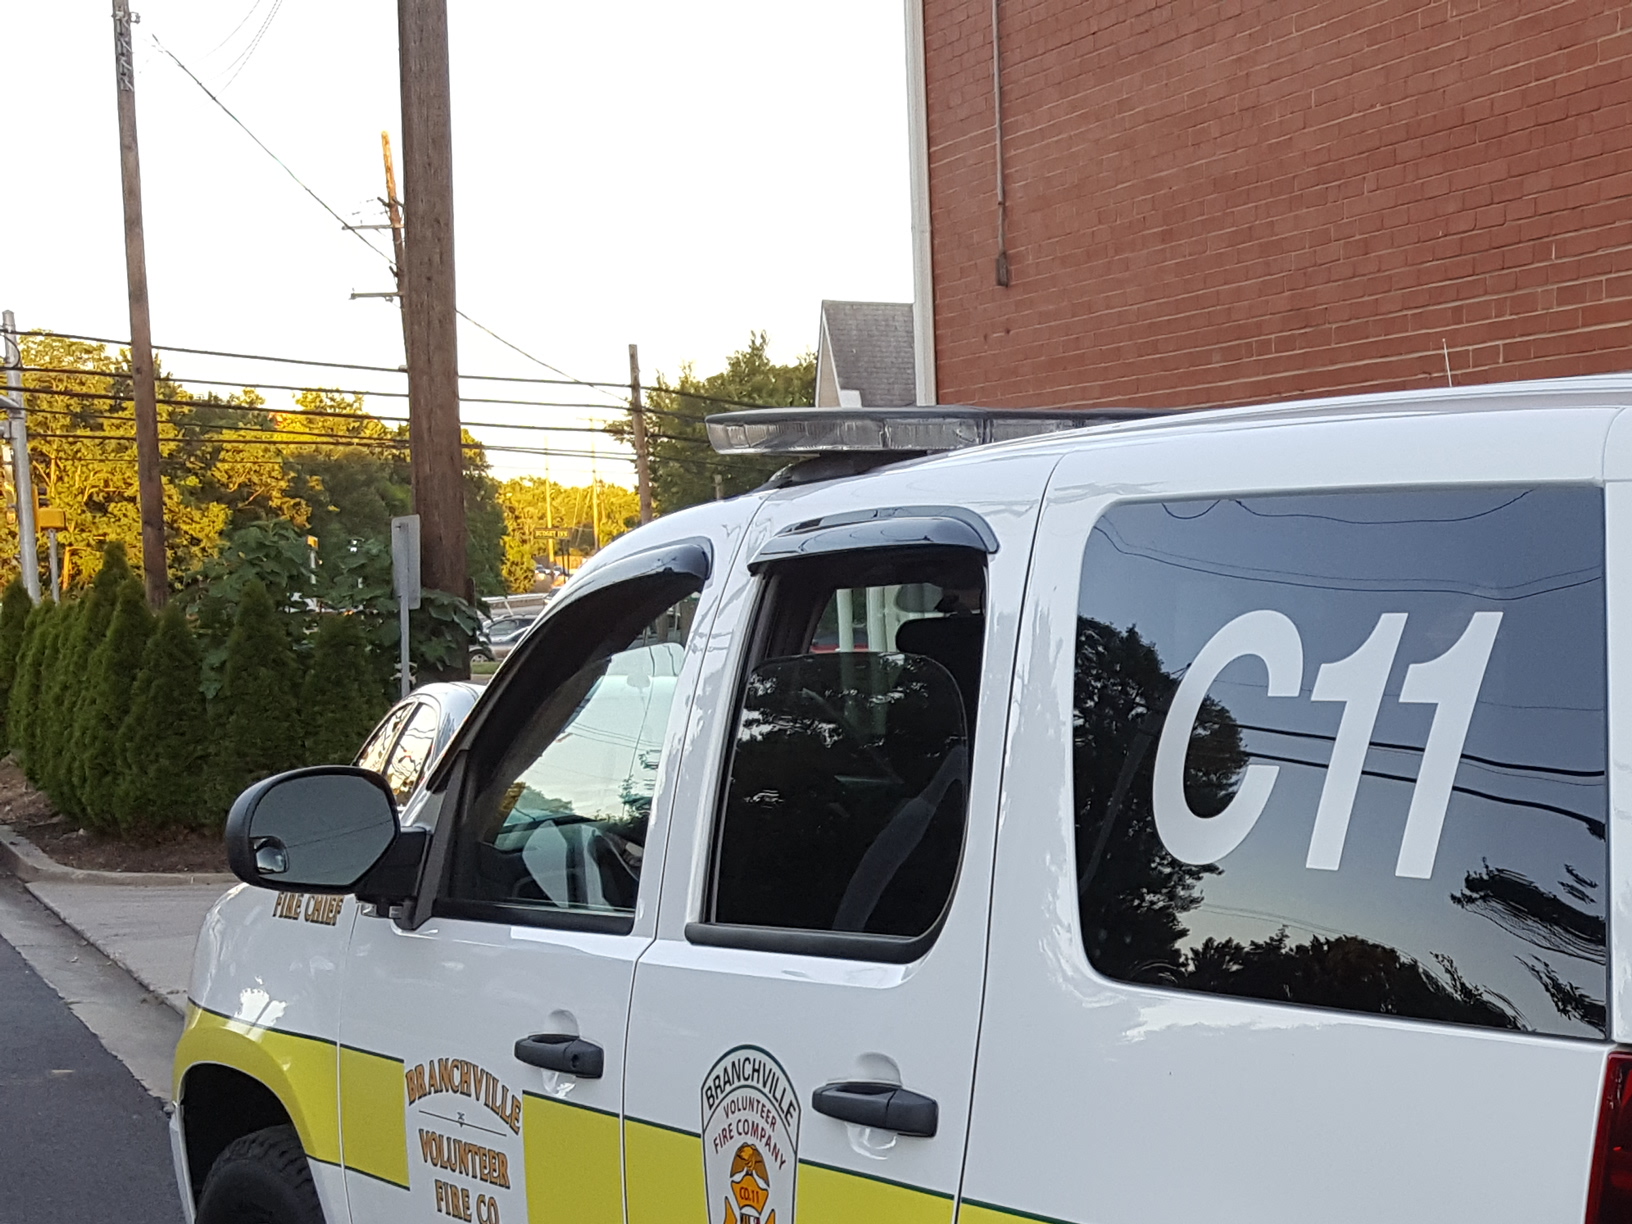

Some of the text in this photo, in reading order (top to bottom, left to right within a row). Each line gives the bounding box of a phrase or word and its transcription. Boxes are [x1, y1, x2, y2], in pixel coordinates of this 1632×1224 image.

[1152, 609, 1504, 880] C11
[272, 891, 345, 927] FIRE CHIEF
[405, 1058, 523, 1136] BRANCHVILLE
[705, 1057, 796, 1128] BRANCHVILLE
[723, 1095, 777, 1133] VOLUNTEER
[418, 1128, 511, 1190] VOLUNTEER
[713, 1118, 787, 1171] FIRE COMPANY
[434, 1179, 472, 1224] FIRE
